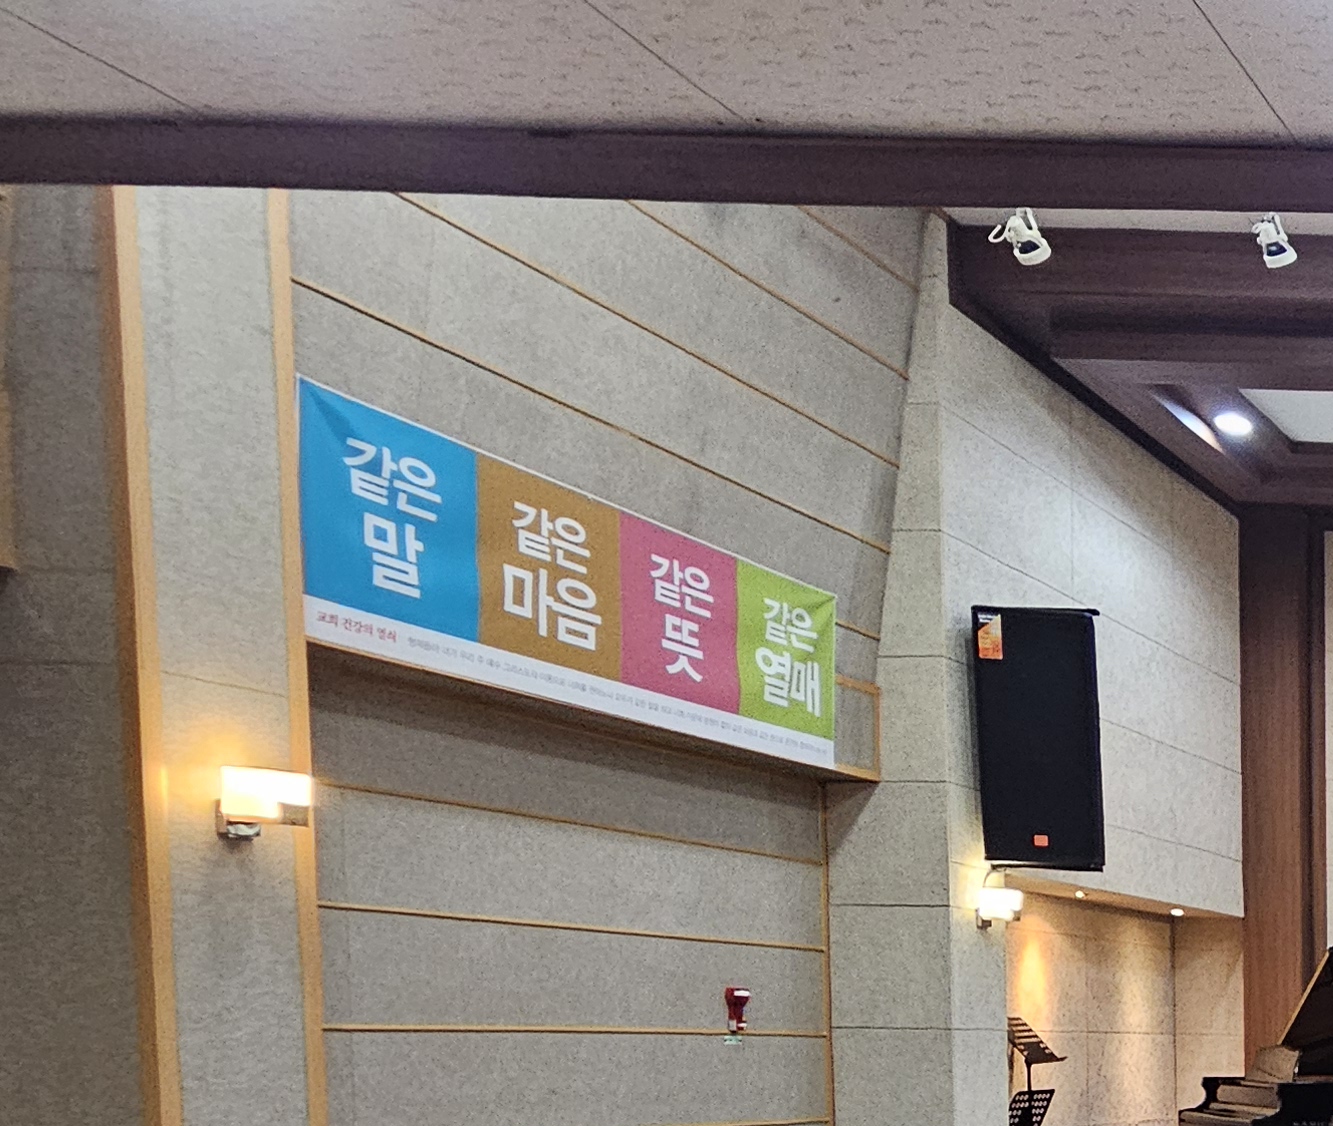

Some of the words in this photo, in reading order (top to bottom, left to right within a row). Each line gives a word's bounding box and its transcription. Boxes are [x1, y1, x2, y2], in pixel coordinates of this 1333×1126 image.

[342, 436, 442, 522] 같은
[363, 512, 425, 599] 말
[512, 500, 591, 574] 같은
[502, 563, 603, 651] 마음
[650, 553, 714, 619] 같은
[316, 610, 338, 627] 교회
[342, 616, 373, 636] 건강의
[377, 626, 396, 642] 열쇠
[661, 613, 705, 683] 뜻
[762, 597, 818, 653] 같은
[755, 648, 822, 718] 열매
